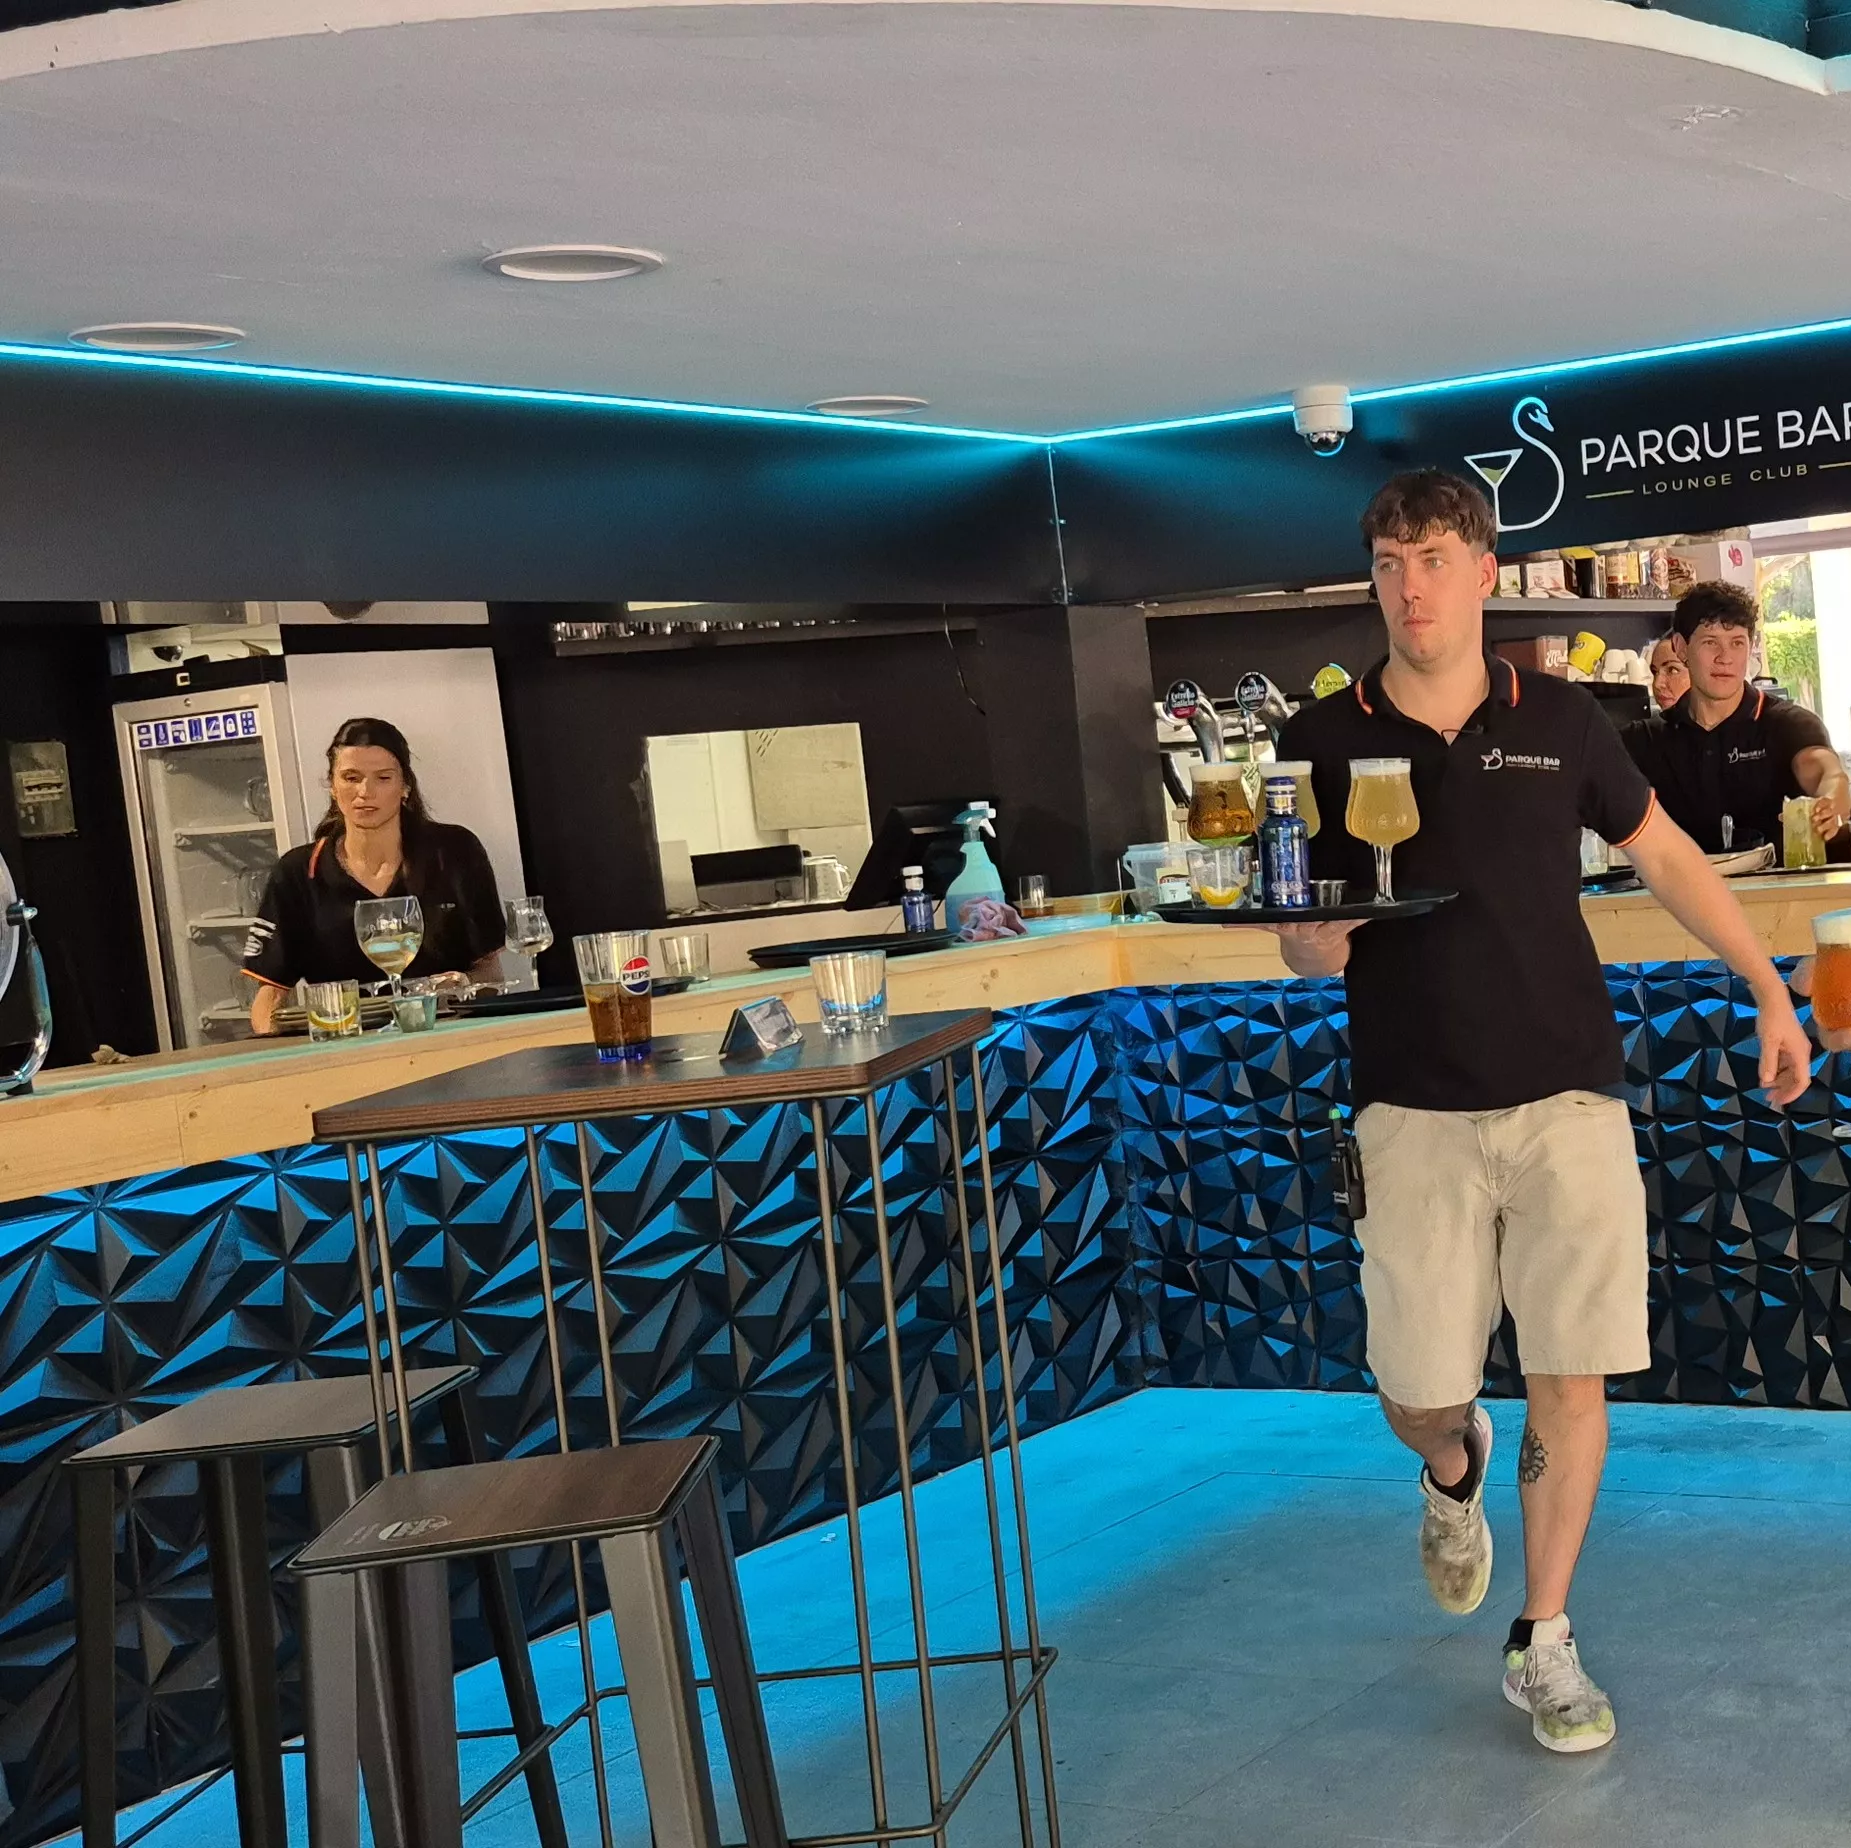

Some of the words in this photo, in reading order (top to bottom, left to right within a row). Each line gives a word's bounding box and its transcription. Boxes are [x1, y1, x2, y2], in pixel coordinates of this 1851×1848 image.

[1580, 414, 1763, 476] PARQUE
[1642, 473, 1733, 495] LOUNGE
[1749, 463, 1808, 481] CLUB
[1505, 754, 1542, 765] PARQUE
[622, 970, 650, 981] PEPS
